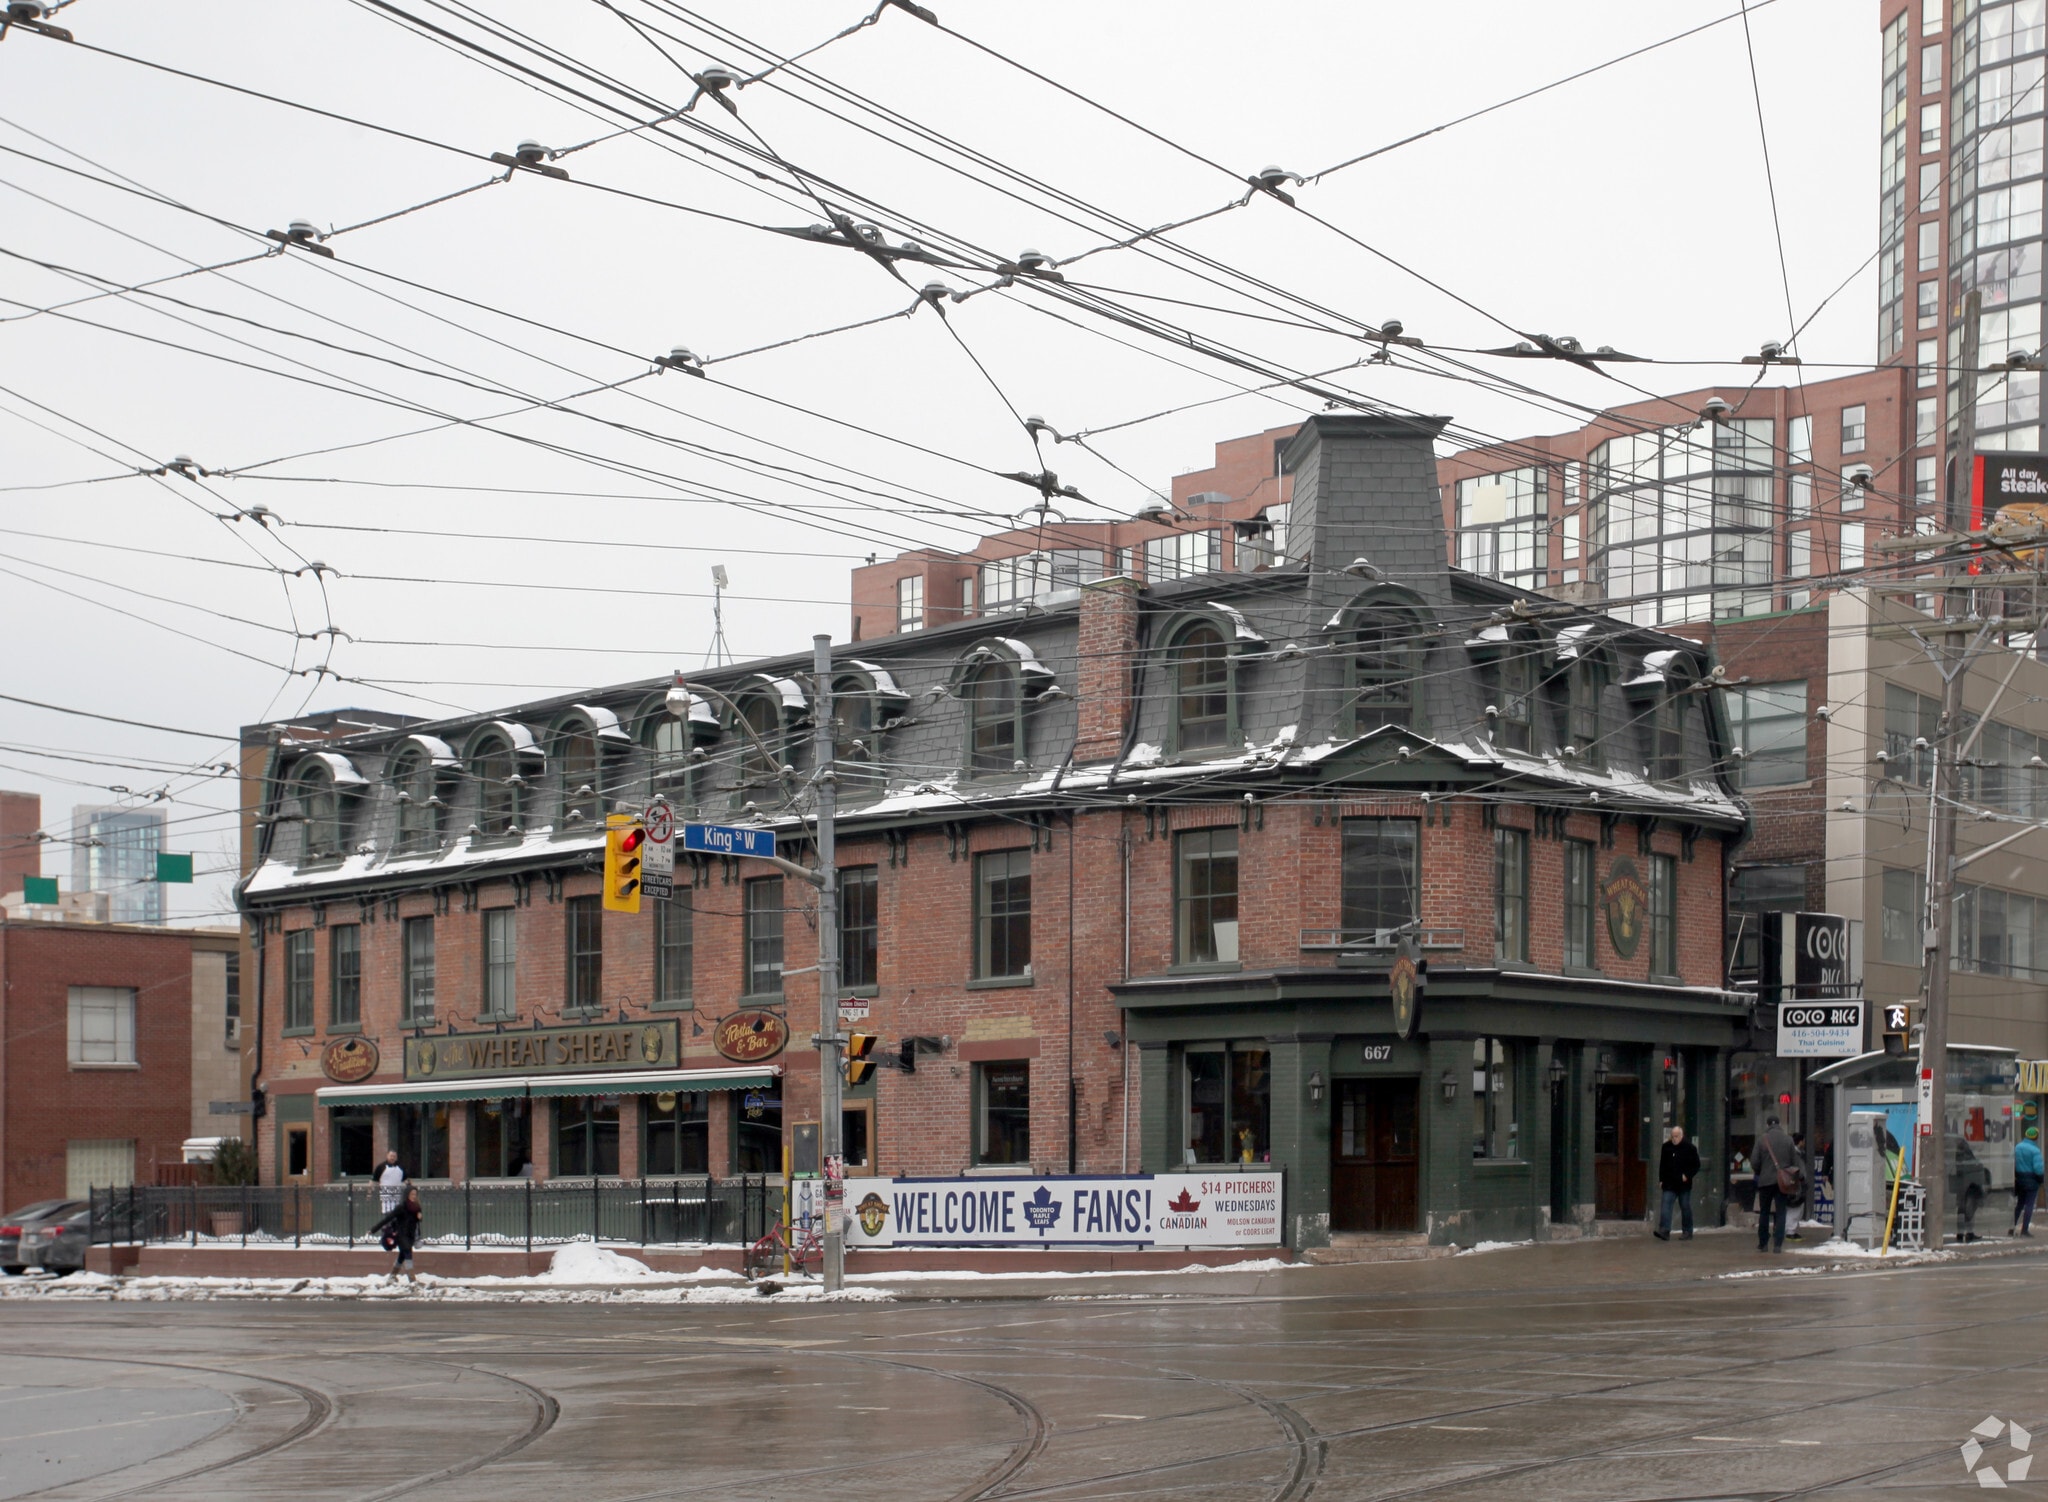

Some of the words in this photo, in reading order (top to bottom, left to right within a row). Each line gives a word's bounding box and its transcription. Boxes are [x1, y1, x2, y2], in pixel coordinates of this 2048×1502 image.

[2001, 468, 2015, 479] All
[2019, 468, 2038, 481] day
[704, 827, 732, 852] King
[735, 830, 742, 841] St
[744, 832, 755, 850] W
[641, 873, 672, 887] STREETCARS
[643, 885, 669, 897] EXCEPTED
[1786, 1009, 1825, 1025] COCO
[1831, 1009, 1856, 1024] RICE
[467, 1035, 549, 1069] WHEAT
[554, 1031, 633, 1065] SHEAF
[735, 1039, 746, 1054] &
[747, 1035, 768, 1052] Bar
[1364, 1045, 1392, 1060] 667
[1201, 1181, 1222, 1196] $14
[1225, 1181, 1275, 1194] PITCHERS!
[894, 1190, 1015, 1234] WELCOME
[1073, 1189, 1152, 1234] FANS!
[1215, 1199, 1275, 1212] WEDNESDAYS
[1159, 1217, 1207, 1229] CANADIAN
[1251, 1217, 1275, 1225] CANADIAN
[1243, 1228, 1260, 1236] COORS
[1261, 1227, 1275, 1235] LIGHT
